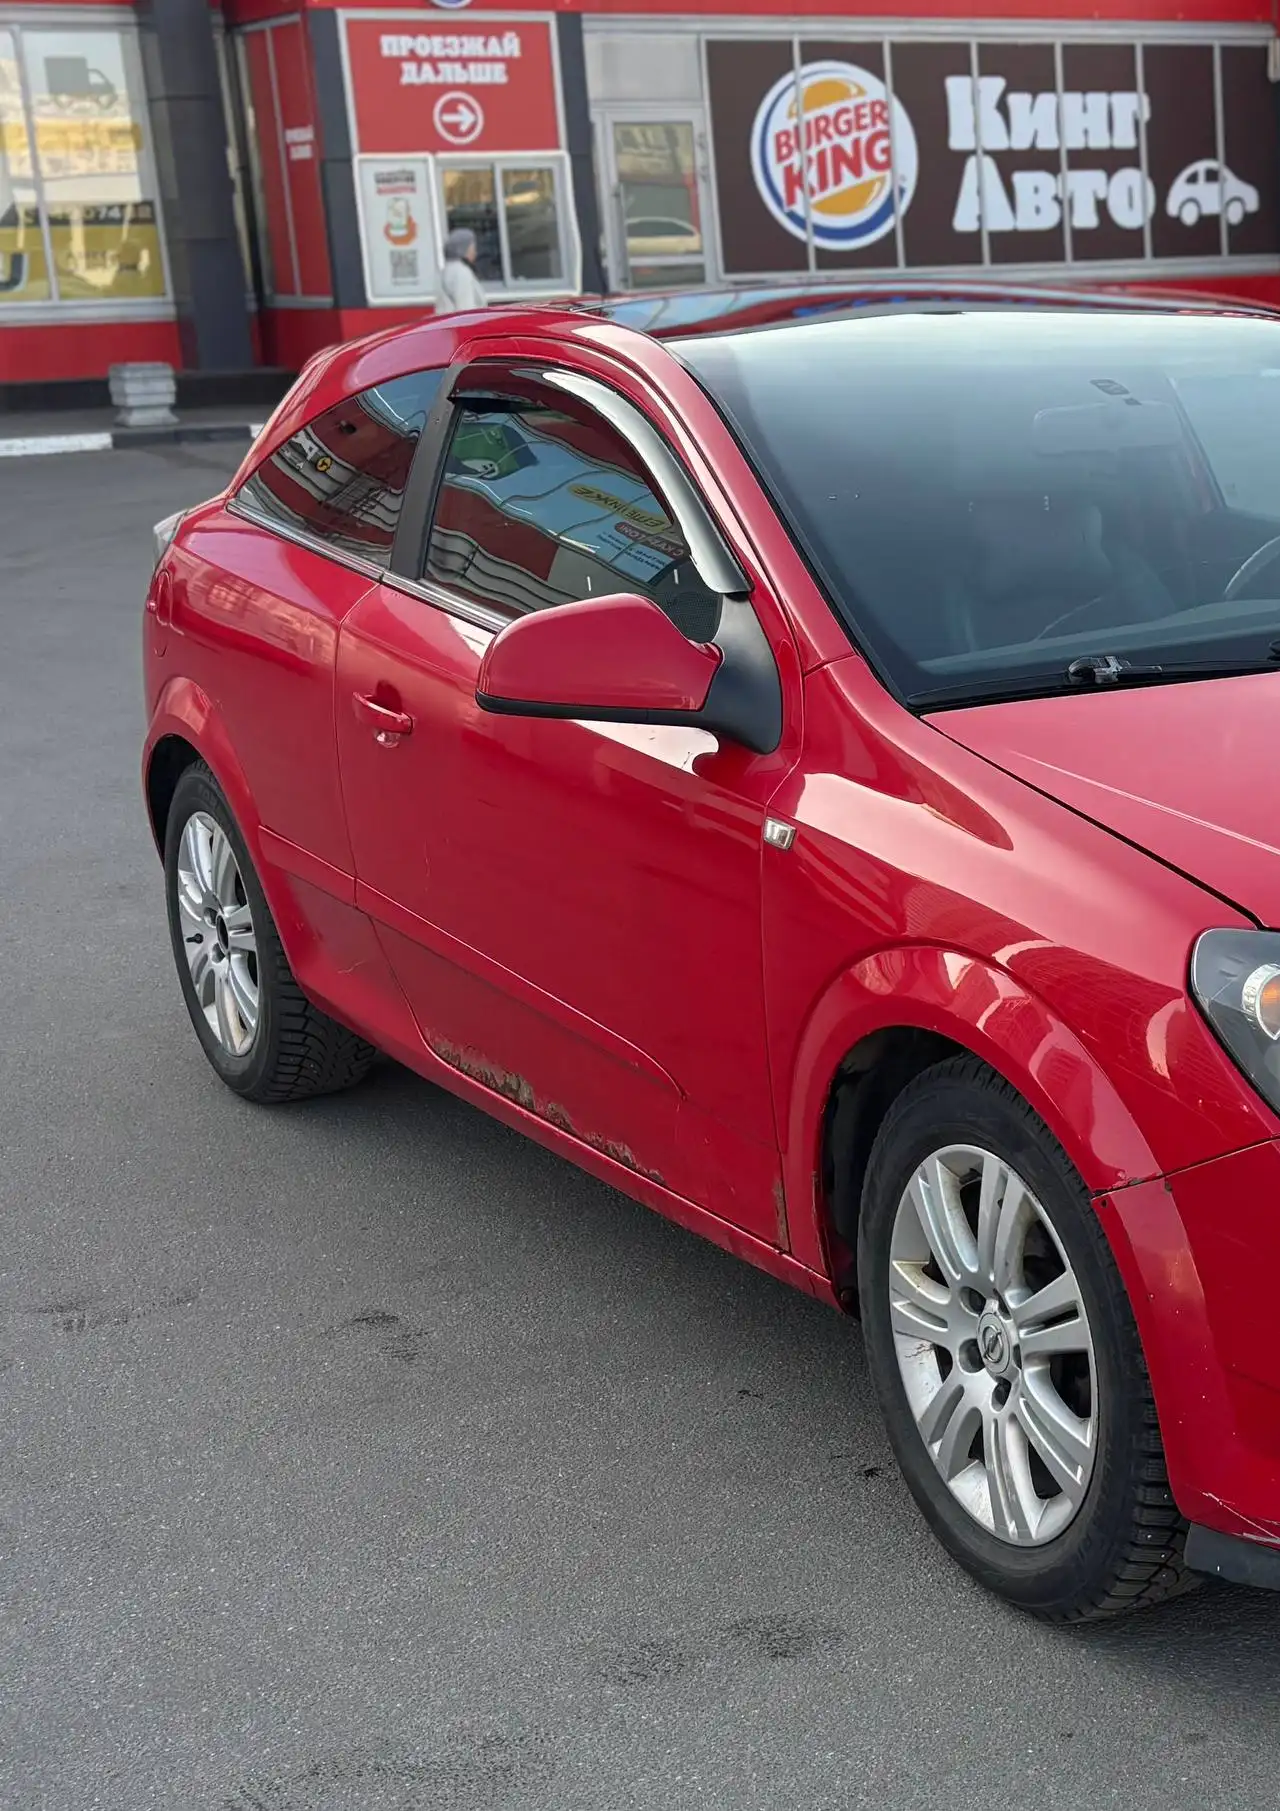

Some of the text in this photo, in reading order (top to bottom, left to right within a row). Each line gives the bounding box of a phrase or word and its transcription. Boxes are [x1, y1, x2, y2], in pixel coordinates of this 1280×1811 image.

[380, 32, 521, 57] ПРОЕЗЖАЙ
[400, 61, 508, 85] ДАЛЬШЕ
[774, 99, 890, 165] BURGER
[783, 129, 893, 208] KING
